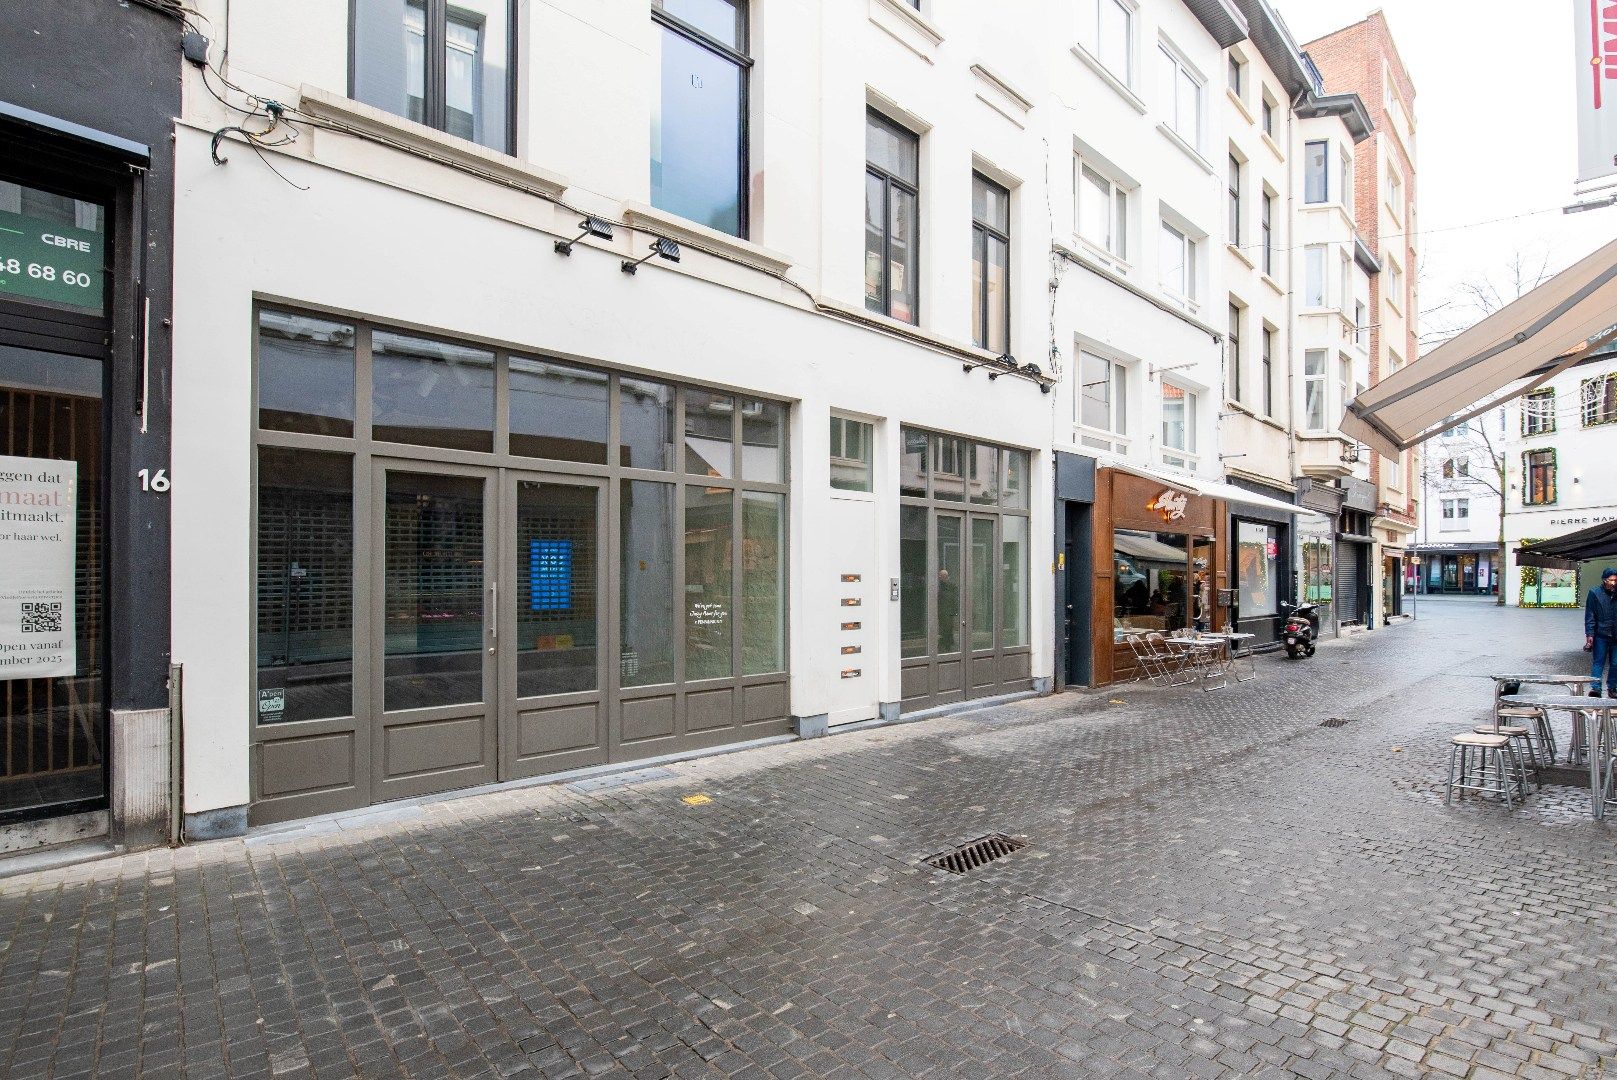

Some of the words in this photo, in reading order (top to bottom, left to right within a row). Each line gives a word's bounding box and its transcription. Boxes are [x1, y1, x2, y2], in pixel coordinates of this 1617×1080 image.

[41, 233, 91, 253] CBRE
[27, 263, 56, 281] 68
[62, 270, 91, 288] 60
[38, 472, 62, 484] dat
[138, 468, 171, 492] 16
[0, 490, 62, 507] maat
[1, 509, 64, 523] itmaakt.
[13, 532, 39, 541] haar
[30, 639, 64, 650] vanaf
[36, 655, 63, 665] 2025
